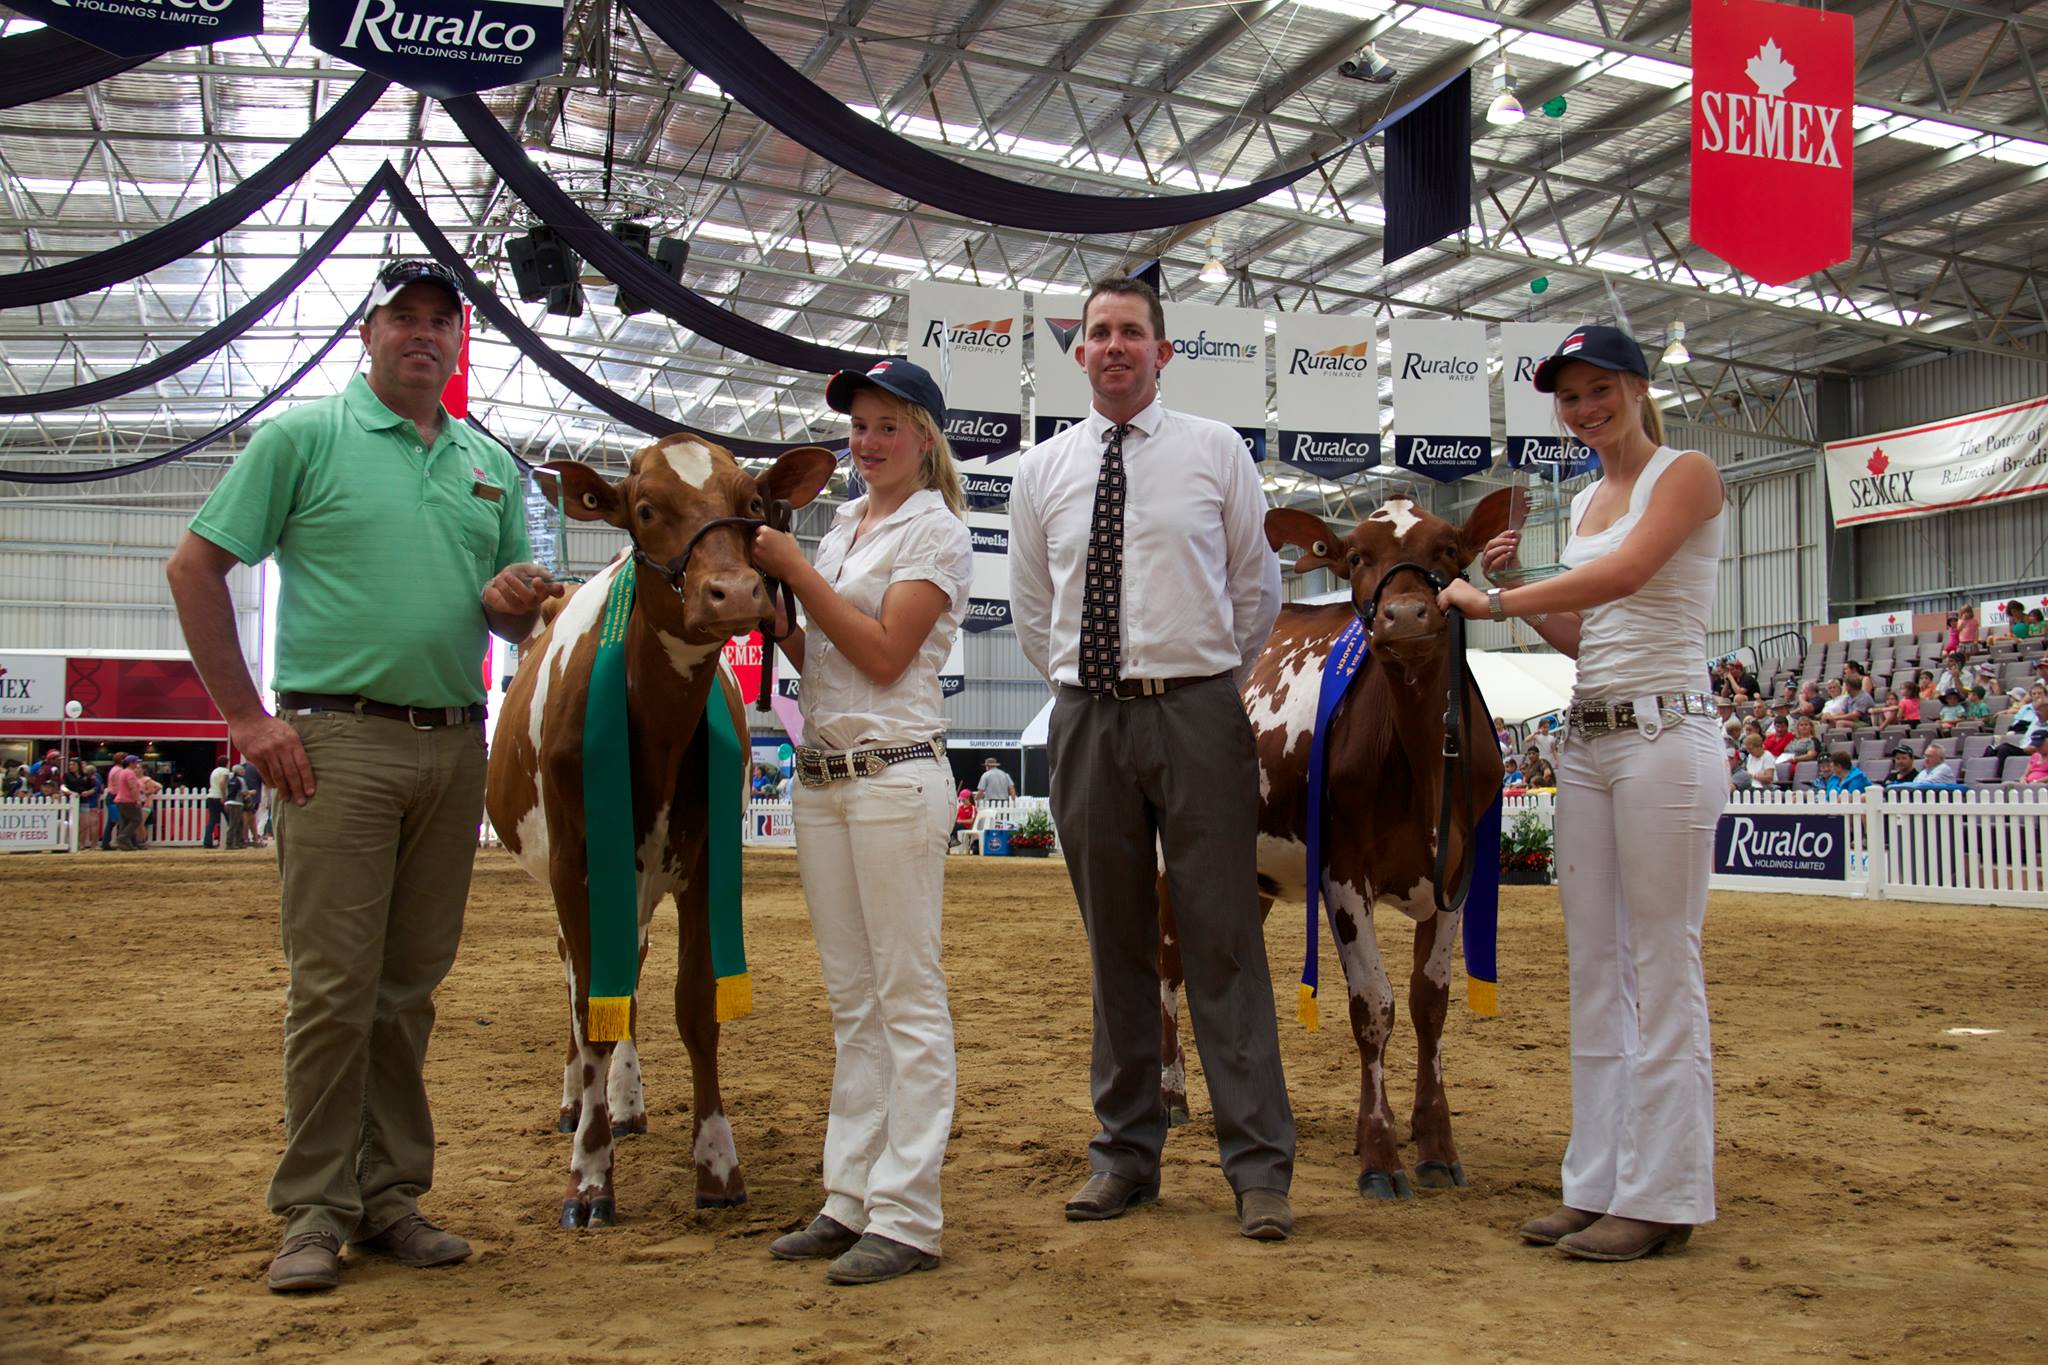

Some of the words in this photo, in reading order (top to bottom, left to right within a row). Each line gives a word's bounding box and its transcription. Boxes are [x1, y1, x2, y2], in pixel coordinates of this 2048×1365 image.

[75, 0, 157, 19] HOLDINGS
[160, 10, 219, 26] LIMITED
[340, 0, 536, 52] Ruralco
[397, 44, 467, 60] HOLDINGS
[470, 53, 523, 65] LIMITED
[1701, 90, 1843, 168] SEMEX
[922, 319, 1011, 348] Ruralco
[1172, 330, 1240, 360] agfarm
[954, 344, 1006, 354] PROPERTY
[1289, 348, 1367, 375] Ruralco
[1401, 353, 1478, 379] Ruralco
[944, 416, 1008, 437] uralco
[1959, 440, 1981, 457] The
[1986, 431, 2025, 451] Power
[2027, 422, 2045, 446] of
[1292, 434, 1370, 462] Ruralco
[1407, 438, 1481, 465] Ruralco
[1519, 439, 1591, 466] Ruralco
[1940, 463, 1998, 486] Balanced
[1849, 470, 1915, 508] SEMEX
[1881, 623, 1905, 635] SEMEX
[1337, 637, 1357, 670] LEADER
[2, 704, 17, 714] for
[969, 740, 1003, 748] SUREFOOT
[0, 814, 50, 829] IDLEY
[773, 827, 792, 836] DAIRY
[20, 831, 49, 840] FEEDS
[1725, 817, 1834, 868] Ruralco
[1754, 859, 1794, 869] HOLDINGS
[1795, 861, 1826, 871] LIMITED
